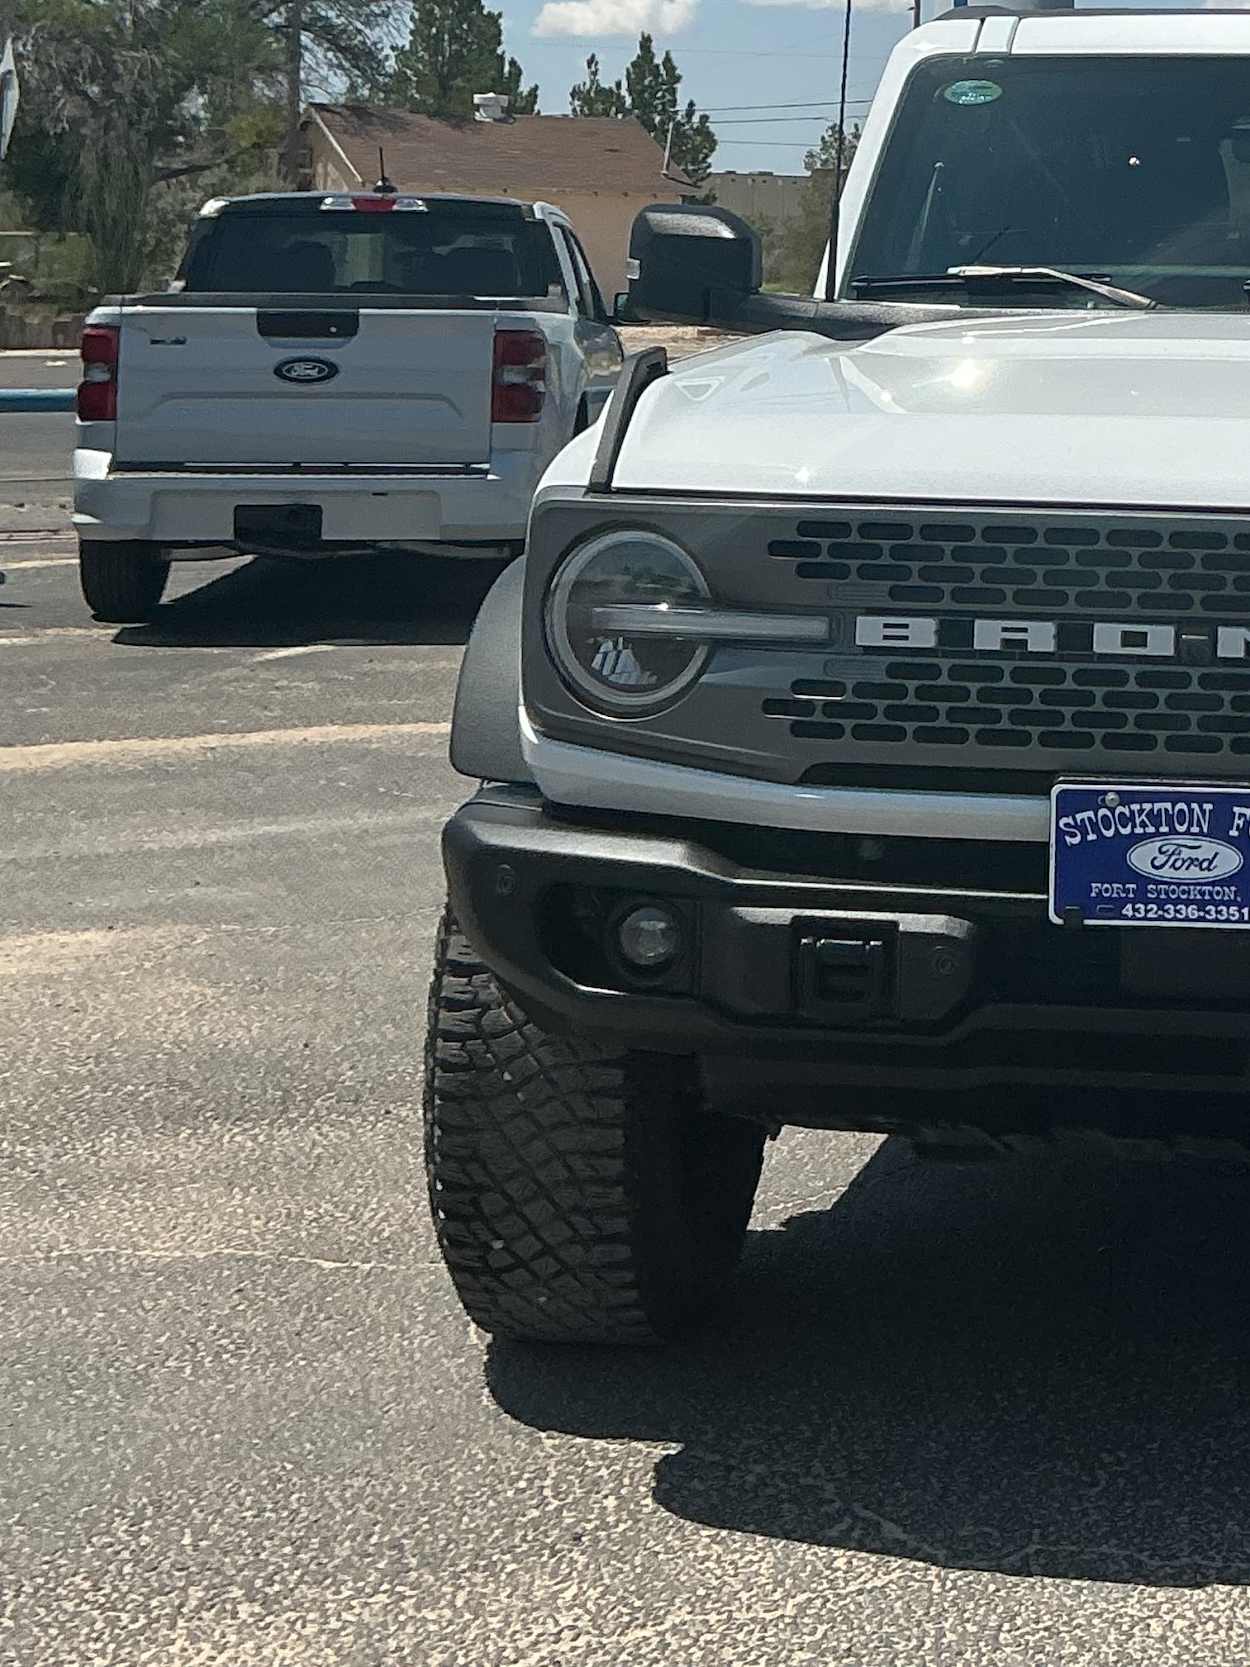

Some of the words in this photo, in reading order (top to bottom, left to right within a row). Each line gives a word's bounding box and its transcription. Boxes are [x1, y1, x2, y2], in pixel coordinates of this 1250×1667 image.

[1058, 801, 1214, 847] STOCKTON
[1150, 843, 1219, 873] Ford
[1089, 883, 1137, 899] FORT
[1120, 902, 1250, 921] 432-336-3351
